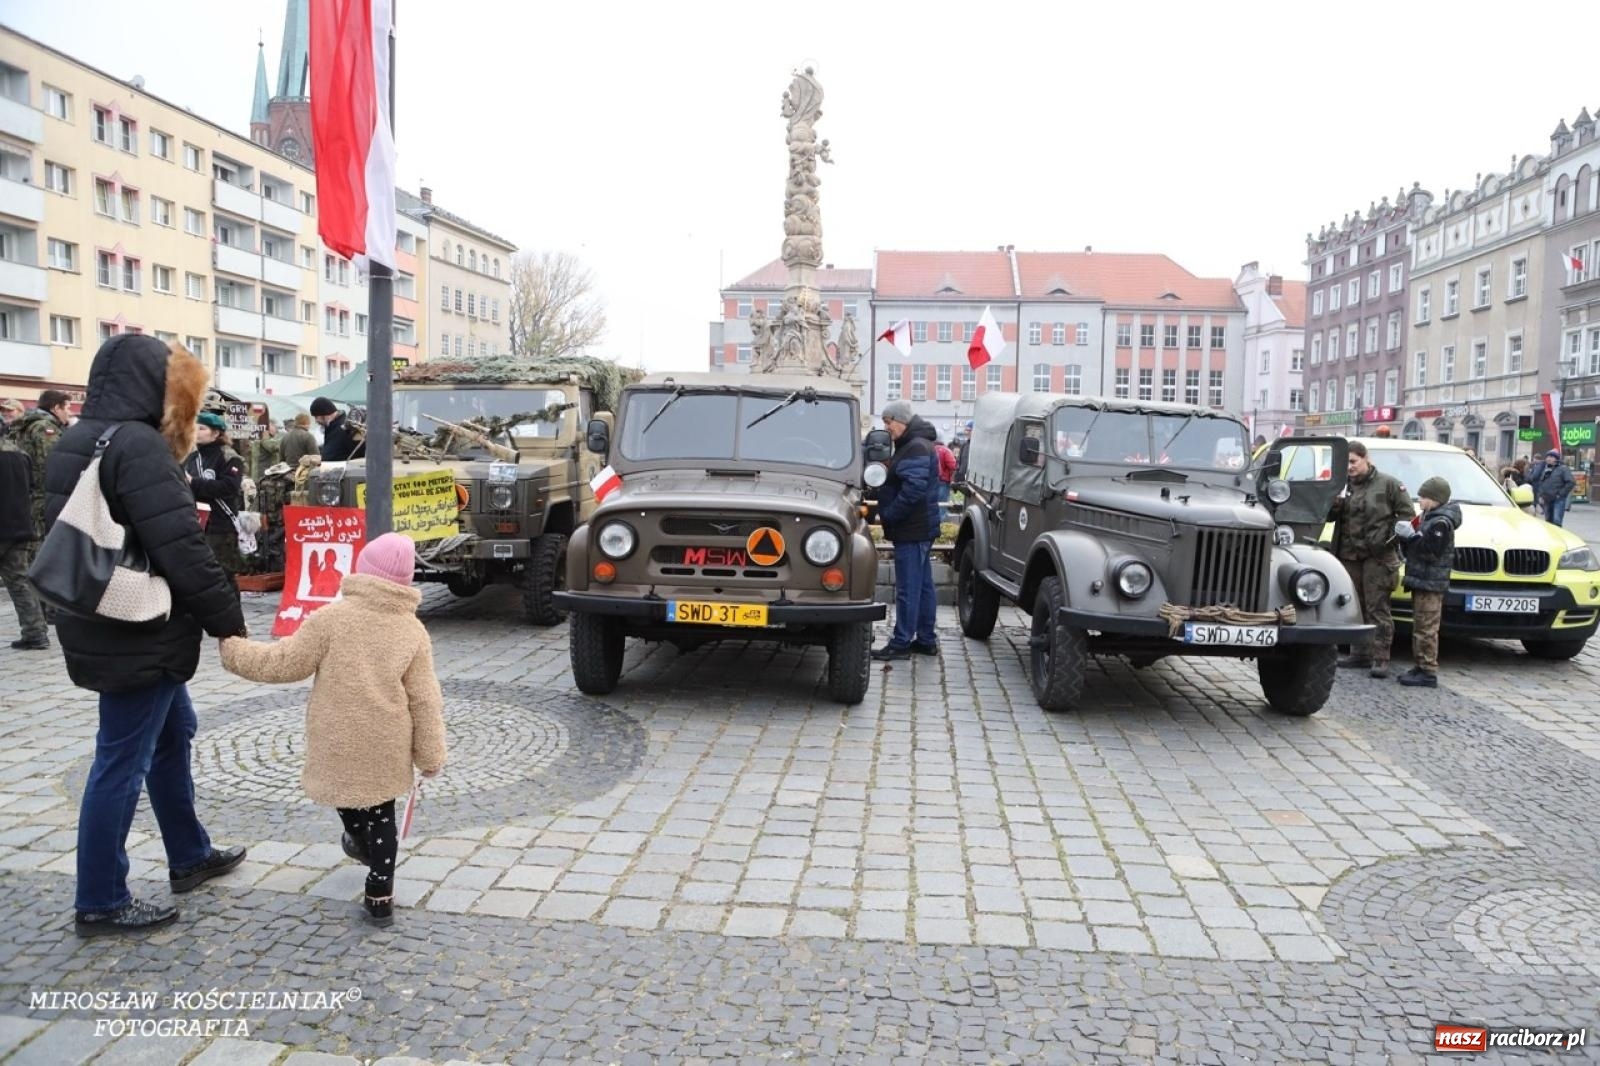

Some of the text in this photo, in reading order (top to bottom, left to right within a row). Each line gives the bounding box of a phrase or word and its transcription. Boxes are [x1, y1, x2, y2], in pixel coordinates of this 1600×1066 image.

[229, 404, 247, 414] GRH
[1563, 427, 1591, 440] żabka
[428, 476, 453, 488] METERS
[398, 490, 411, 498] YOU
[683, 547, 746, 568] MSW
[1475, 597, 1492, 610] SR
[679, 603, 740, 623] SWD 3T
[1195, 626, 1275, 646] SWD A546
